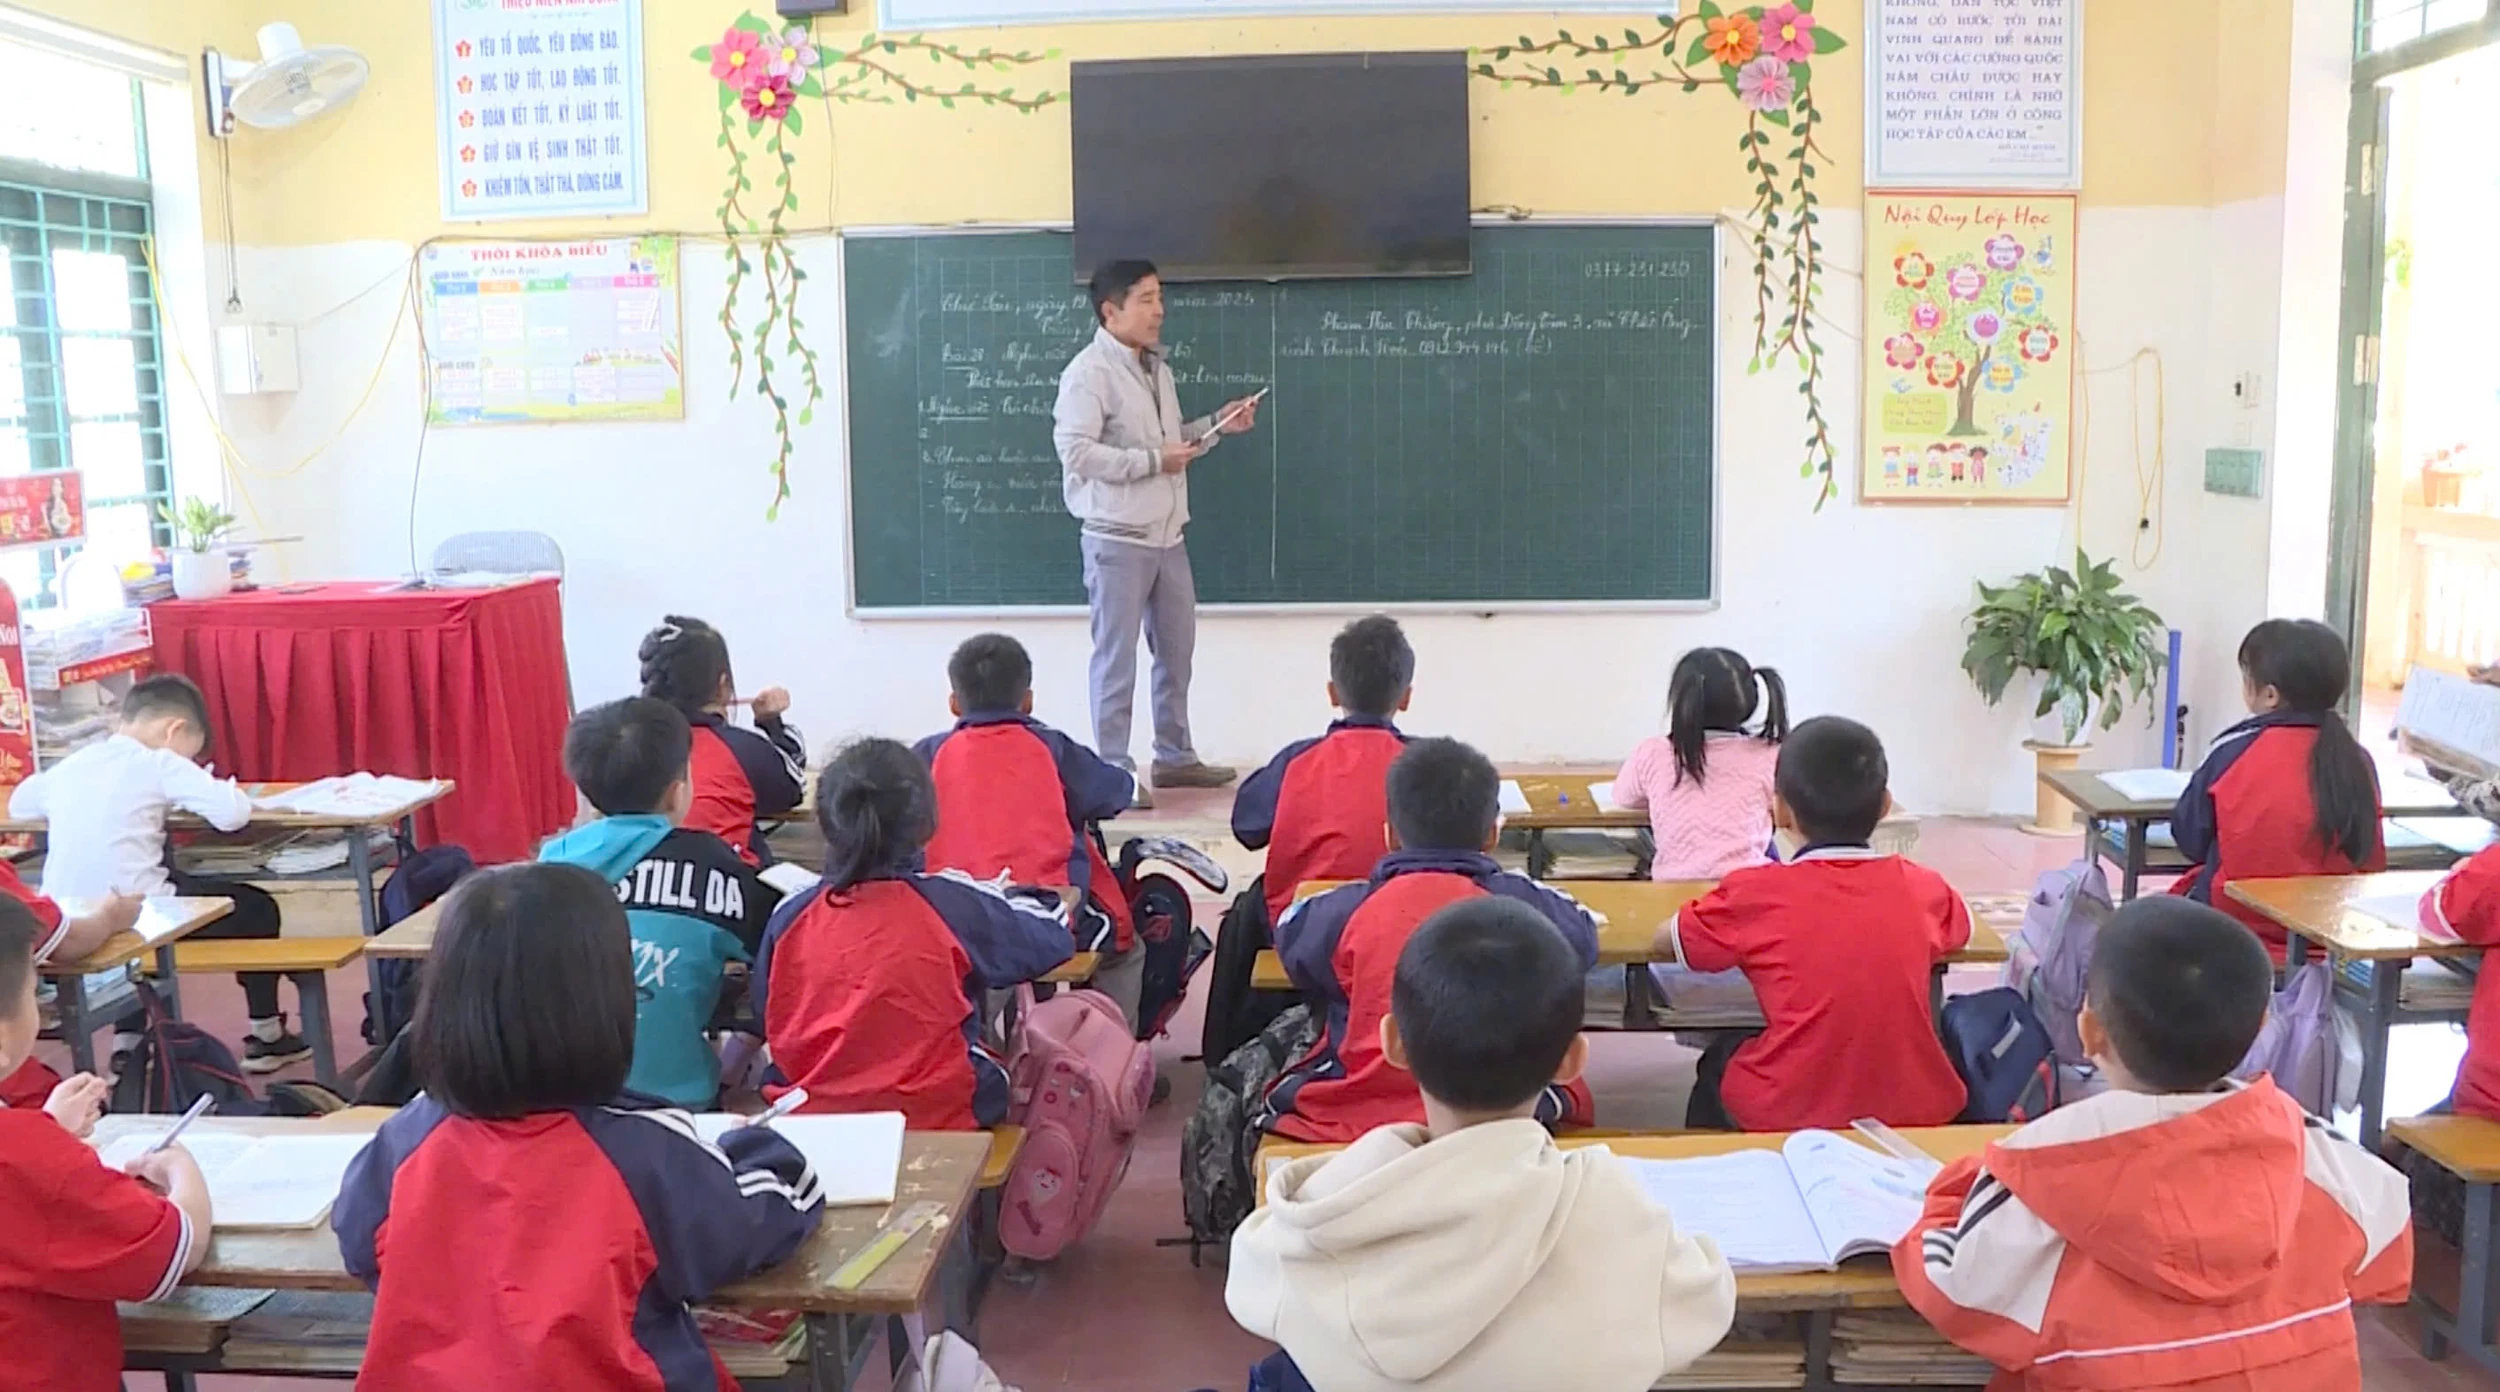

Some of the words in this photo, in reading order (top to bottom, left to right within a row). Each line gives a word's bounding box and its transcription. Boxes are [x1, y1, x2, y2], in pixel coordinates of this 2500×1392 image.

[1885, 16, 1918, 26] NAM
[1928, 14, 1947, 26] CÓ
[1886, 35, 1922, 44] VINH
[1932, 35, 1984, 46] QUANG
[1886, 54, 1910, 64] VAI
[1915, 51, 1940, 64] VỚI
[1943, 52, 1970, 64] CÁC
[1973, 51, 2021, 64] CƯỜNG
[2024, 51, 2063, 65] QUỐC
[550, 70, 567, 88] LAO
[1930, 70, 1970, 82] CHÂU
[2031, 73, 2062, 82] HAY
[2004, 90, 2022, 101] LÀ
[1885, 107, 1917, 122] MỘT
[1924, 105, 1963, 120] PHẦN
[1970, 107, 1999, 120] LỚN
[2023, 107, 2062, 120] CÔNG
[1886, 129, 1915, 142] HỌC
[1946, 125, 1974, 140] CỦA
[1976, 126, 2005, 140] CÁC
[547, 139, 568, 158] SINH
[1884, 204, 1920, 229] Nội
[1927, 204, 1969, 230] Quy
[1974, 204, 2007, 230] Lớp
[2015, 204, 2052, 230] Học
[1026, 294, 1067, 319] ngày
[613, 858, 697, 909] STILL
[704, 868, 745, 920] DA
